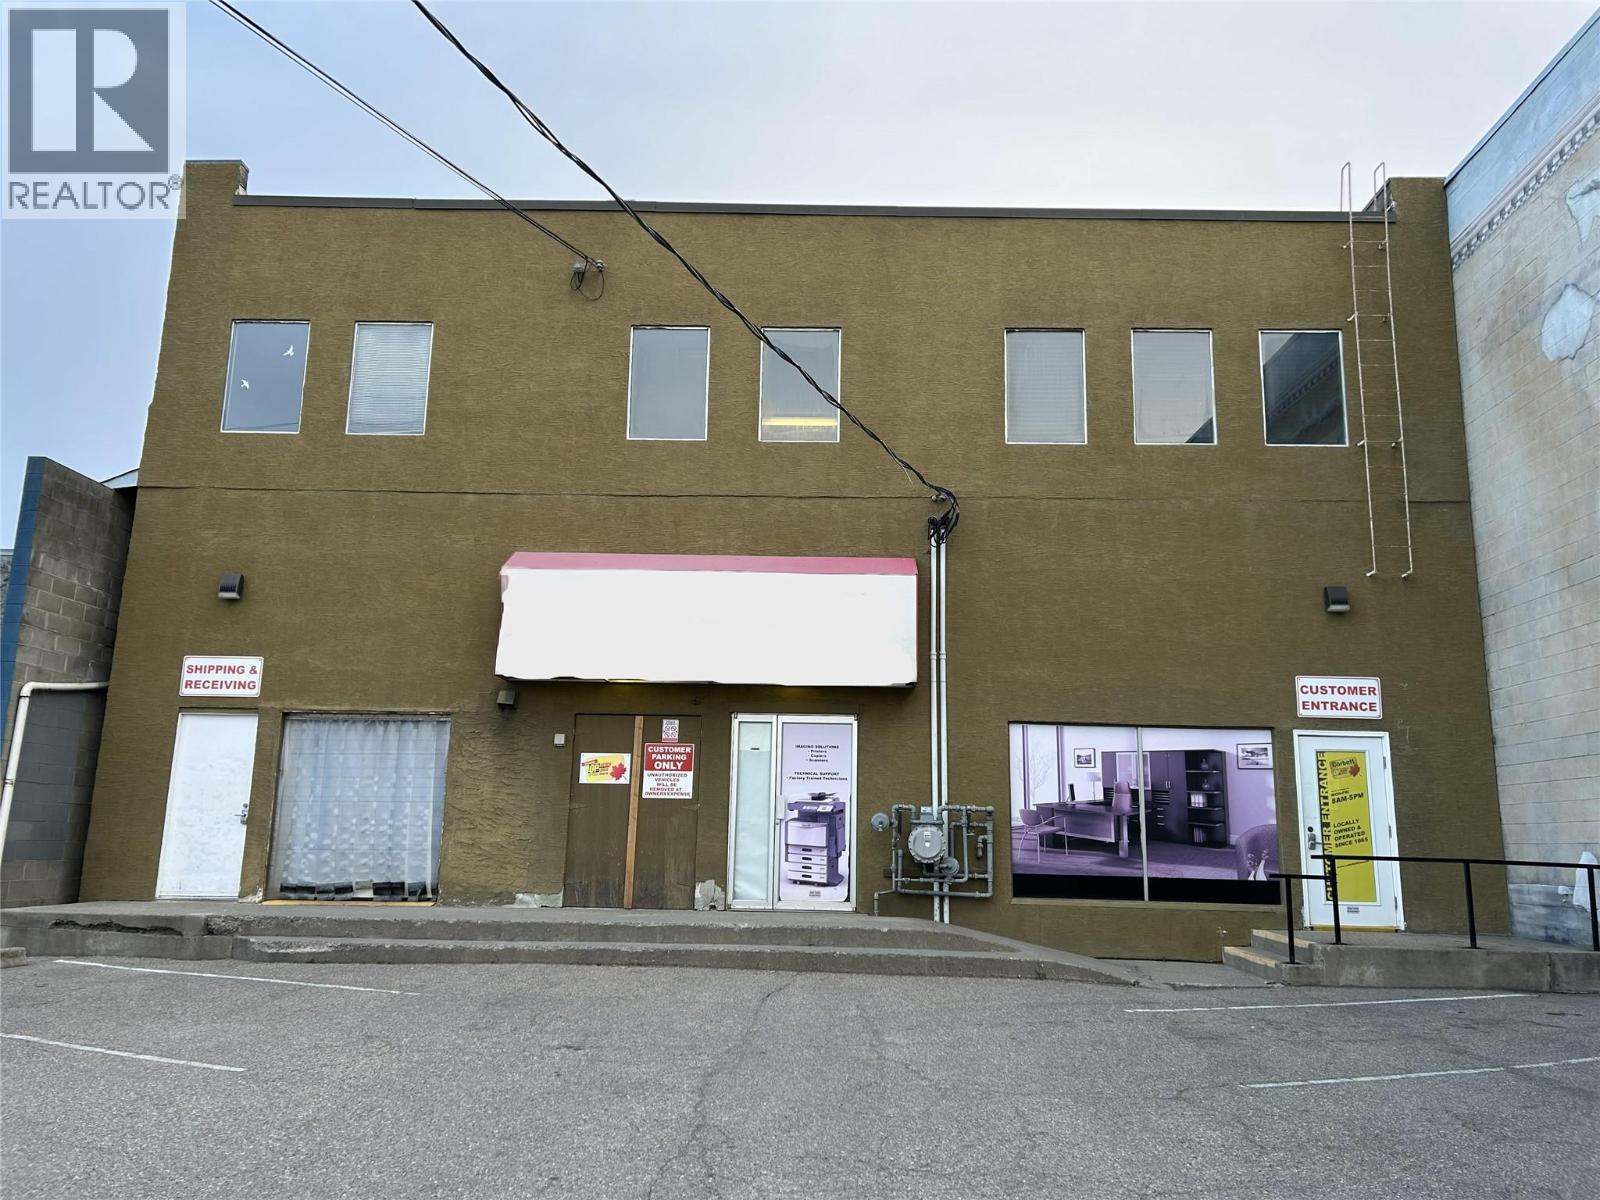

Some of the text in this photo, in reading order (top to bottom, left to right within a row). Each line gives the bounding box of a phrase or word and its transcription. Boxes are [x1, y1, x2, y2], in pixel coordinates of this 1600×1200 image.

[186, 665, 257, 674] SHIPPING &
[184, 680, 256, 690] RECEIVING
[1300, 685, 1376, 696] CUSTOMER
[1302, 701, 1377, 712] ENTRANCE
[654, 761, 684, 770] ONLY
[1318, 752, 1330, 820] ENTRANCE
[1333, 819, 1359, 828] LOCALLY
[1334, 826, 1355, 834] OWNED
[1335, 830, 1365, 841] OPERATED
[1335, 840, 1352, 848] SINCE
